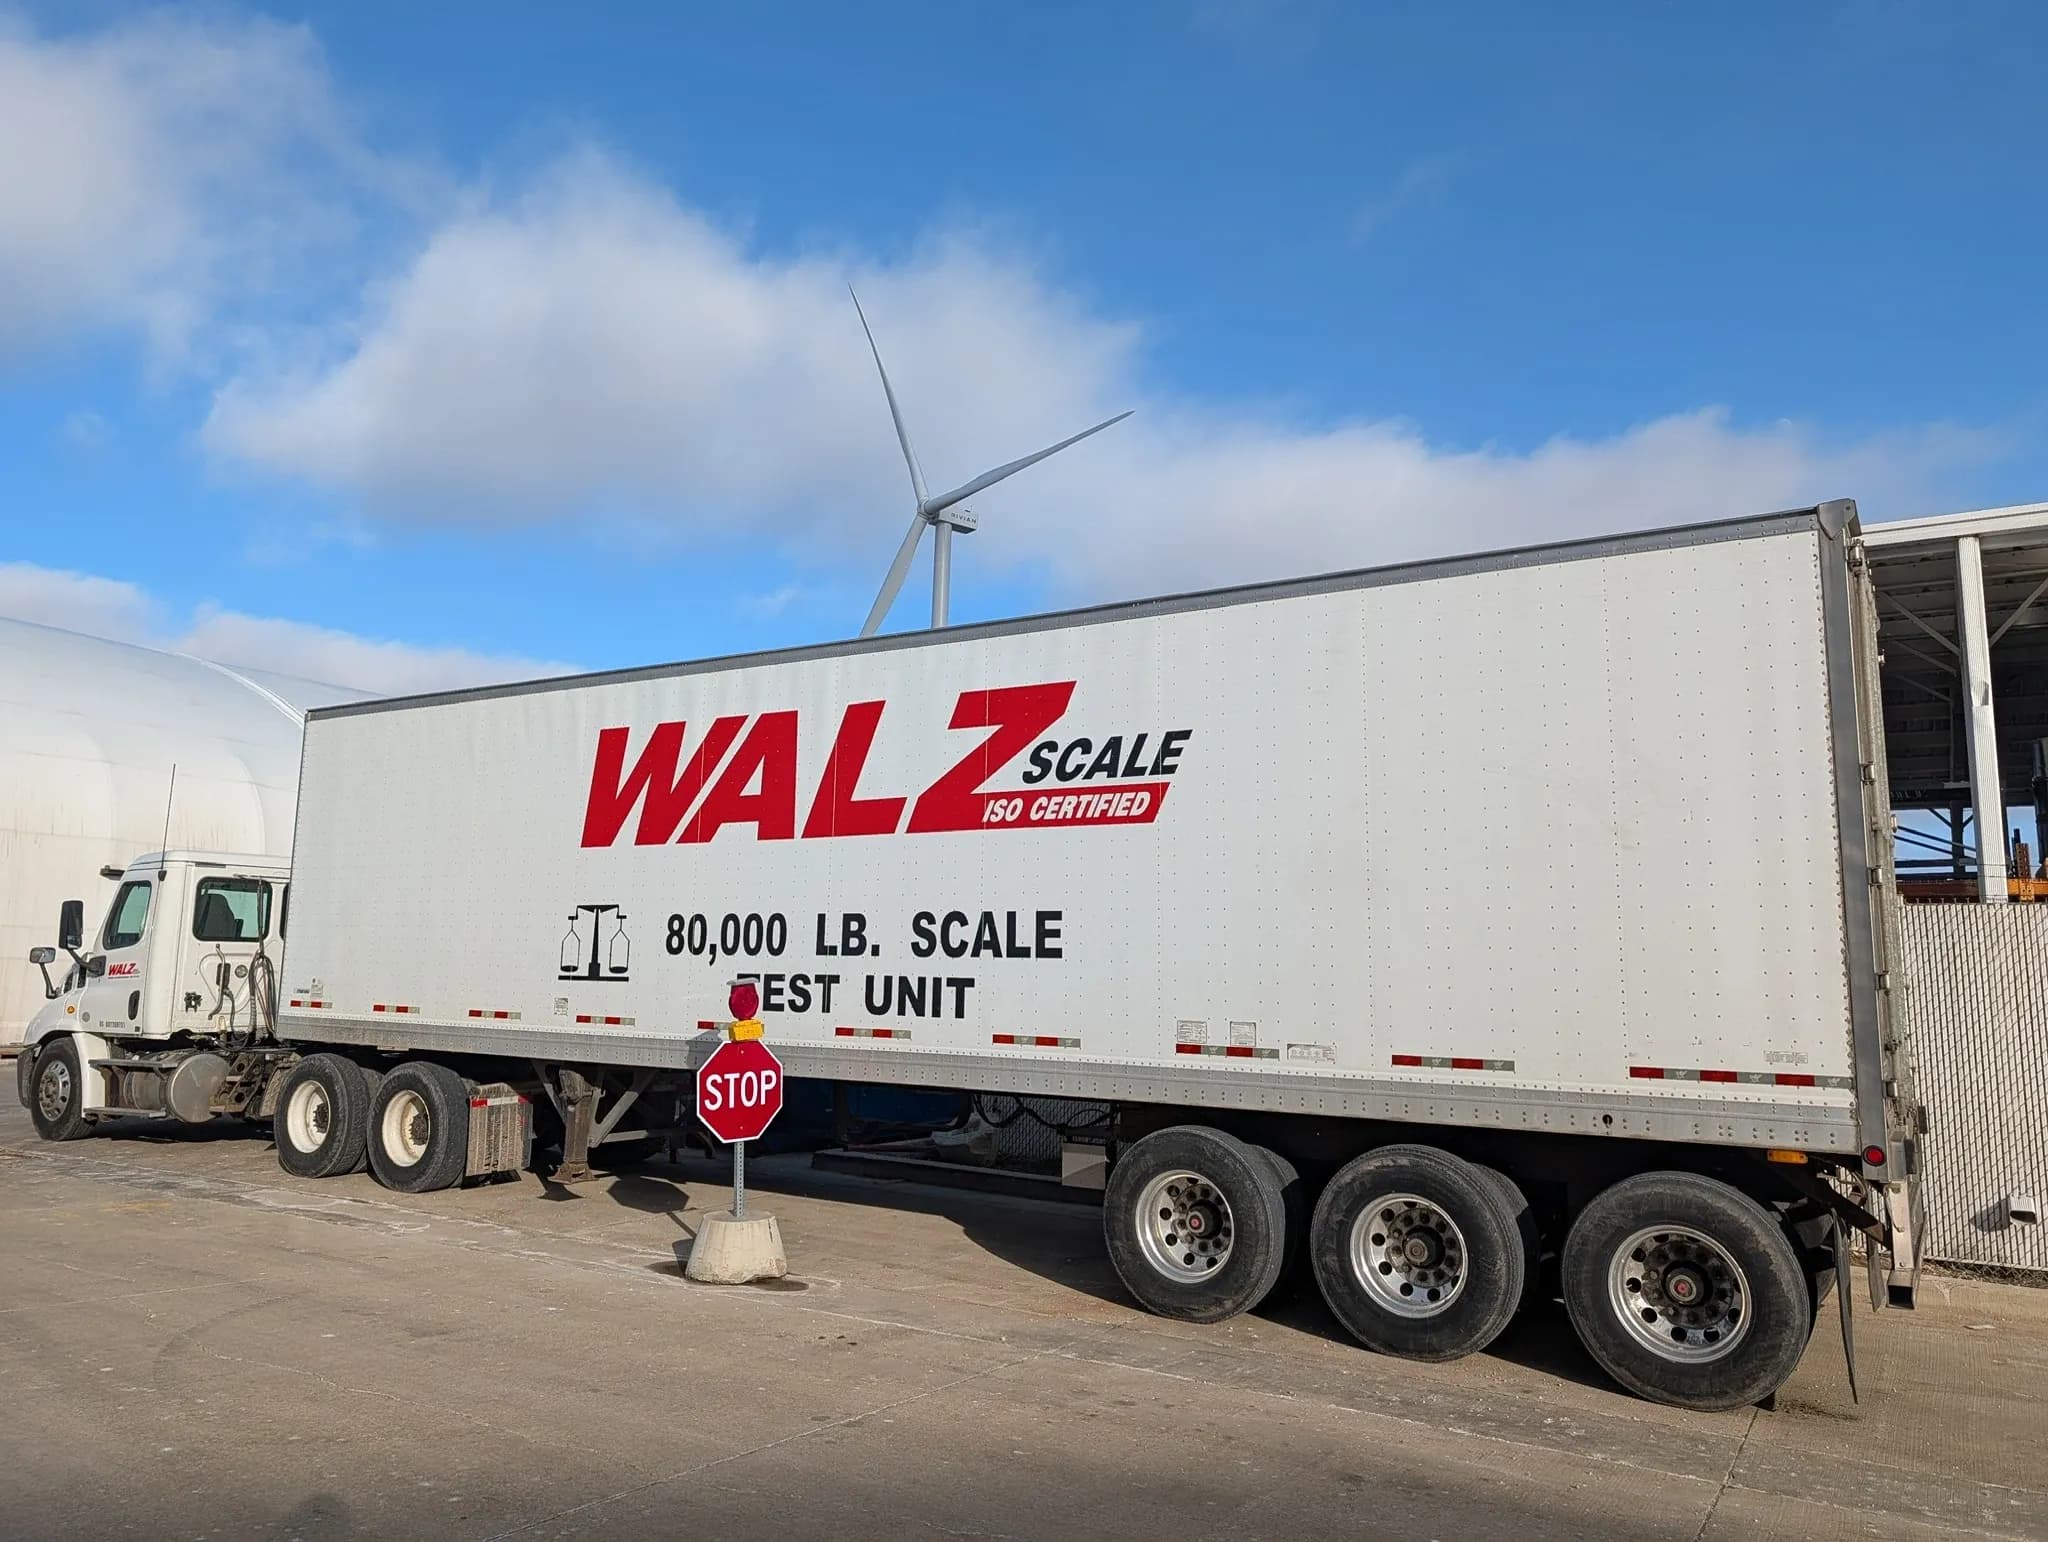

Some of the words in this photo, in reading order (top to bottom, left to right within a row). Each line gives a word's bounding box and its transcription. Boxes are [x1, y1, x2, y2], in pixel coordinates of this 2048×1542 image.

[580, 680, 1077, 847] WALZ
[1022, 729, 1193, 784] SCALE
[981, 798, 1024, 823] ISO
[1030, 791, 1151, 821] CERTIFIED
[665, 913, 787, 965] 80,000
[815, 913, 880, 957] LB.
[910, 910, 1063, 959] SCALE
[108, 963, 136, 976] WALZ
[865, 974, 975, 1019] UNIT
[704, 1069, 777, 1111] STOP
